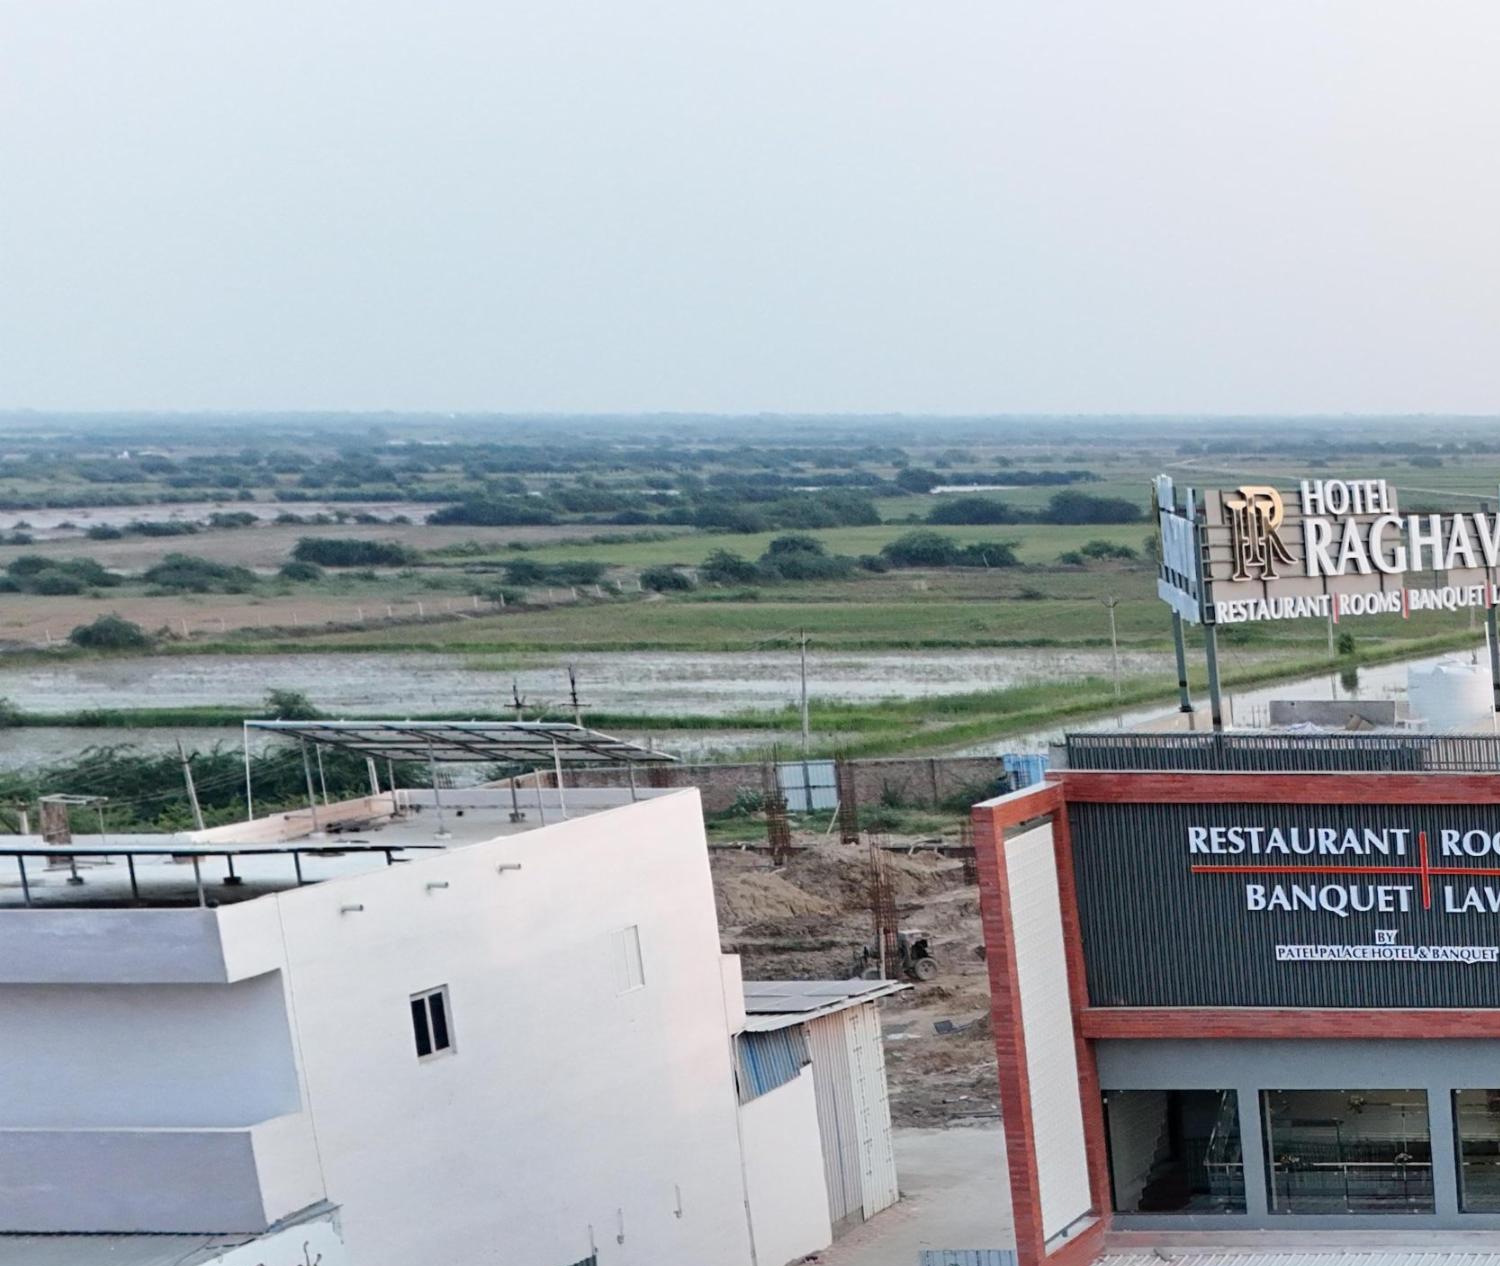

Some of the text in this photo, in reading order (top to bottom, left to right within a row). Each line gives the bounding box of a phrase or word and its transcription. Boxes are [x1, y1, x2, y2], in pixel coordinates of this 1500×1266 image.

[1301, 479, 1395, 516] HOTEL
[1215, 593, 1331, 624] RESTAURANT
[1339, 589, 1401, 616] ROOMS
[1409, 584, 1484, 612] BANQUET
[1188, 826, 1411, 856] RESTAURANT
[1246, 884, 1413, 917] BANQUET
[1376, 930, 1397, 944] BY
[1277, 946, 1498, 963] PATEL PALACE HOTEL & BANQUET
